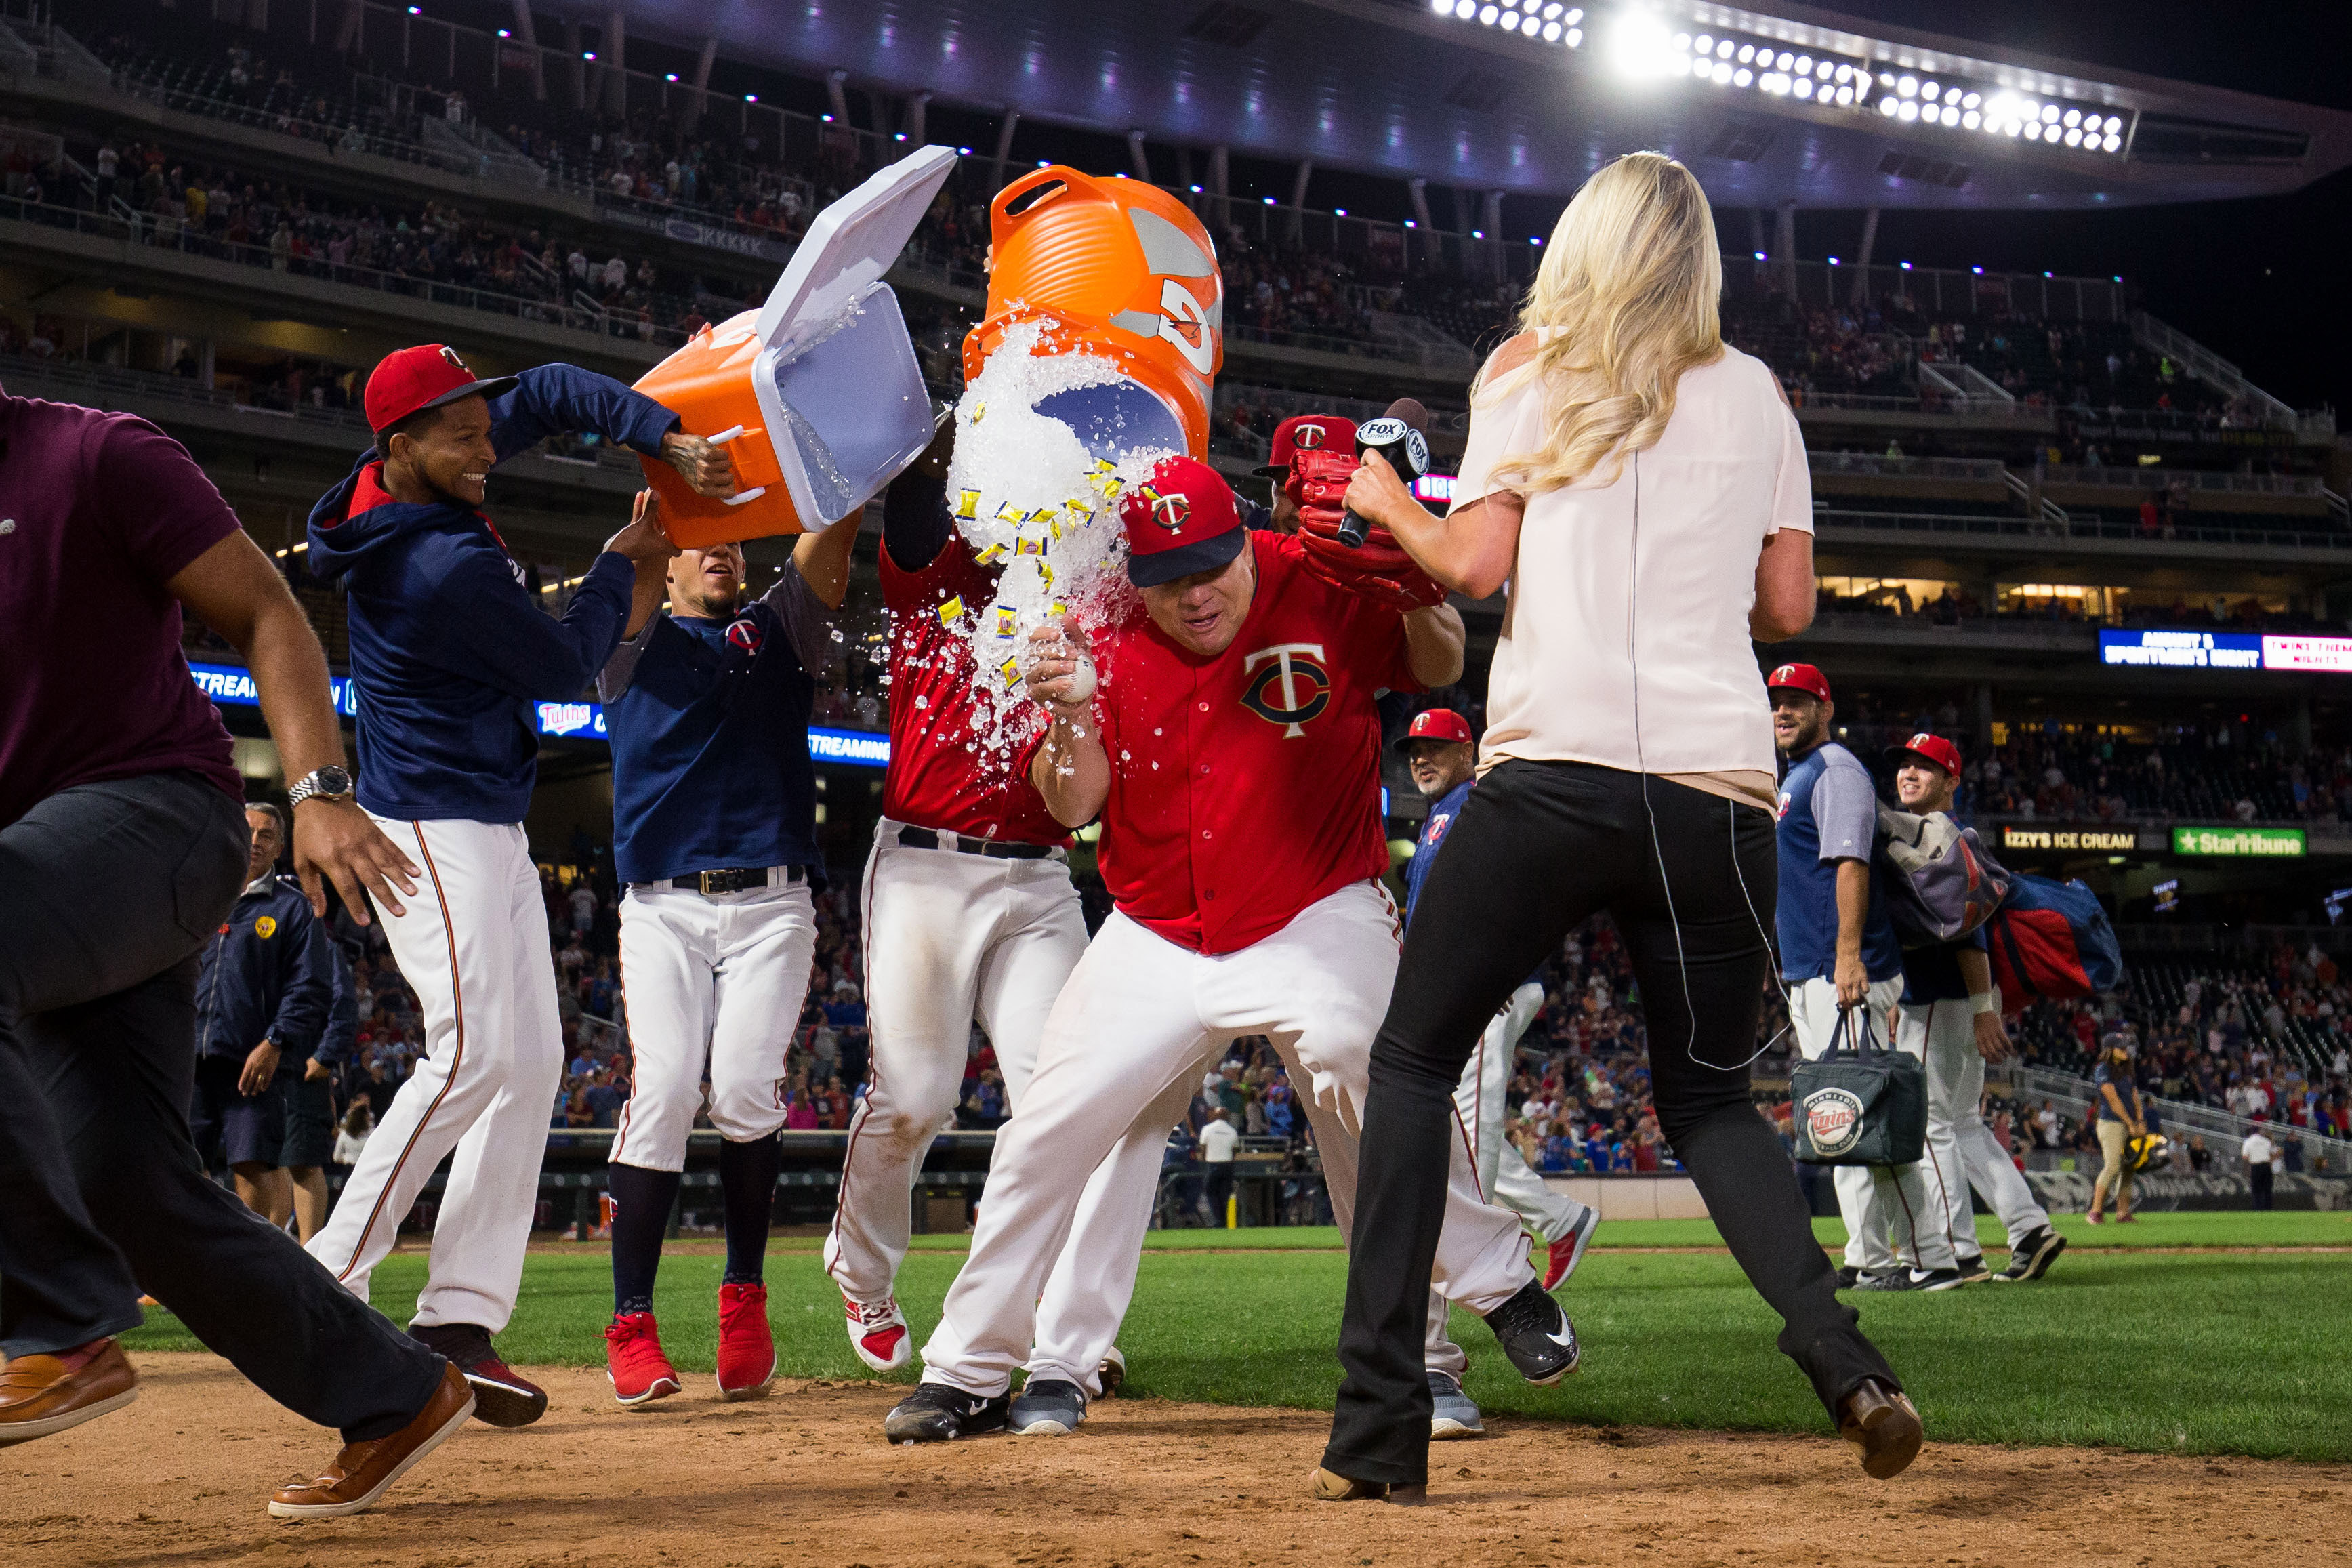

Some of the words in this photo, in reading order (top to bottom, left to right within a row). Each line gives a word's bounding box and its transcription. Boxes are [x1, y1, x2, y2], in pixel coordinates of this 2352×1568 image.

[1367, 424, 1398, 435] FOX
[1411, 434, 1426, 466] FOX
[539, 703, 590, 731] Twins
[2004, 831, 2052, 848] IZZY'S
[2053, 832, 2080, 849] ICE
[2080, 833, 2135, 850] CREAM
[2199, 832, 2302, 854] StarTribune
[1807, 1093, 1857, 1111] MINNESOTA
[1808, 1109, 1856, 1133] Twins
